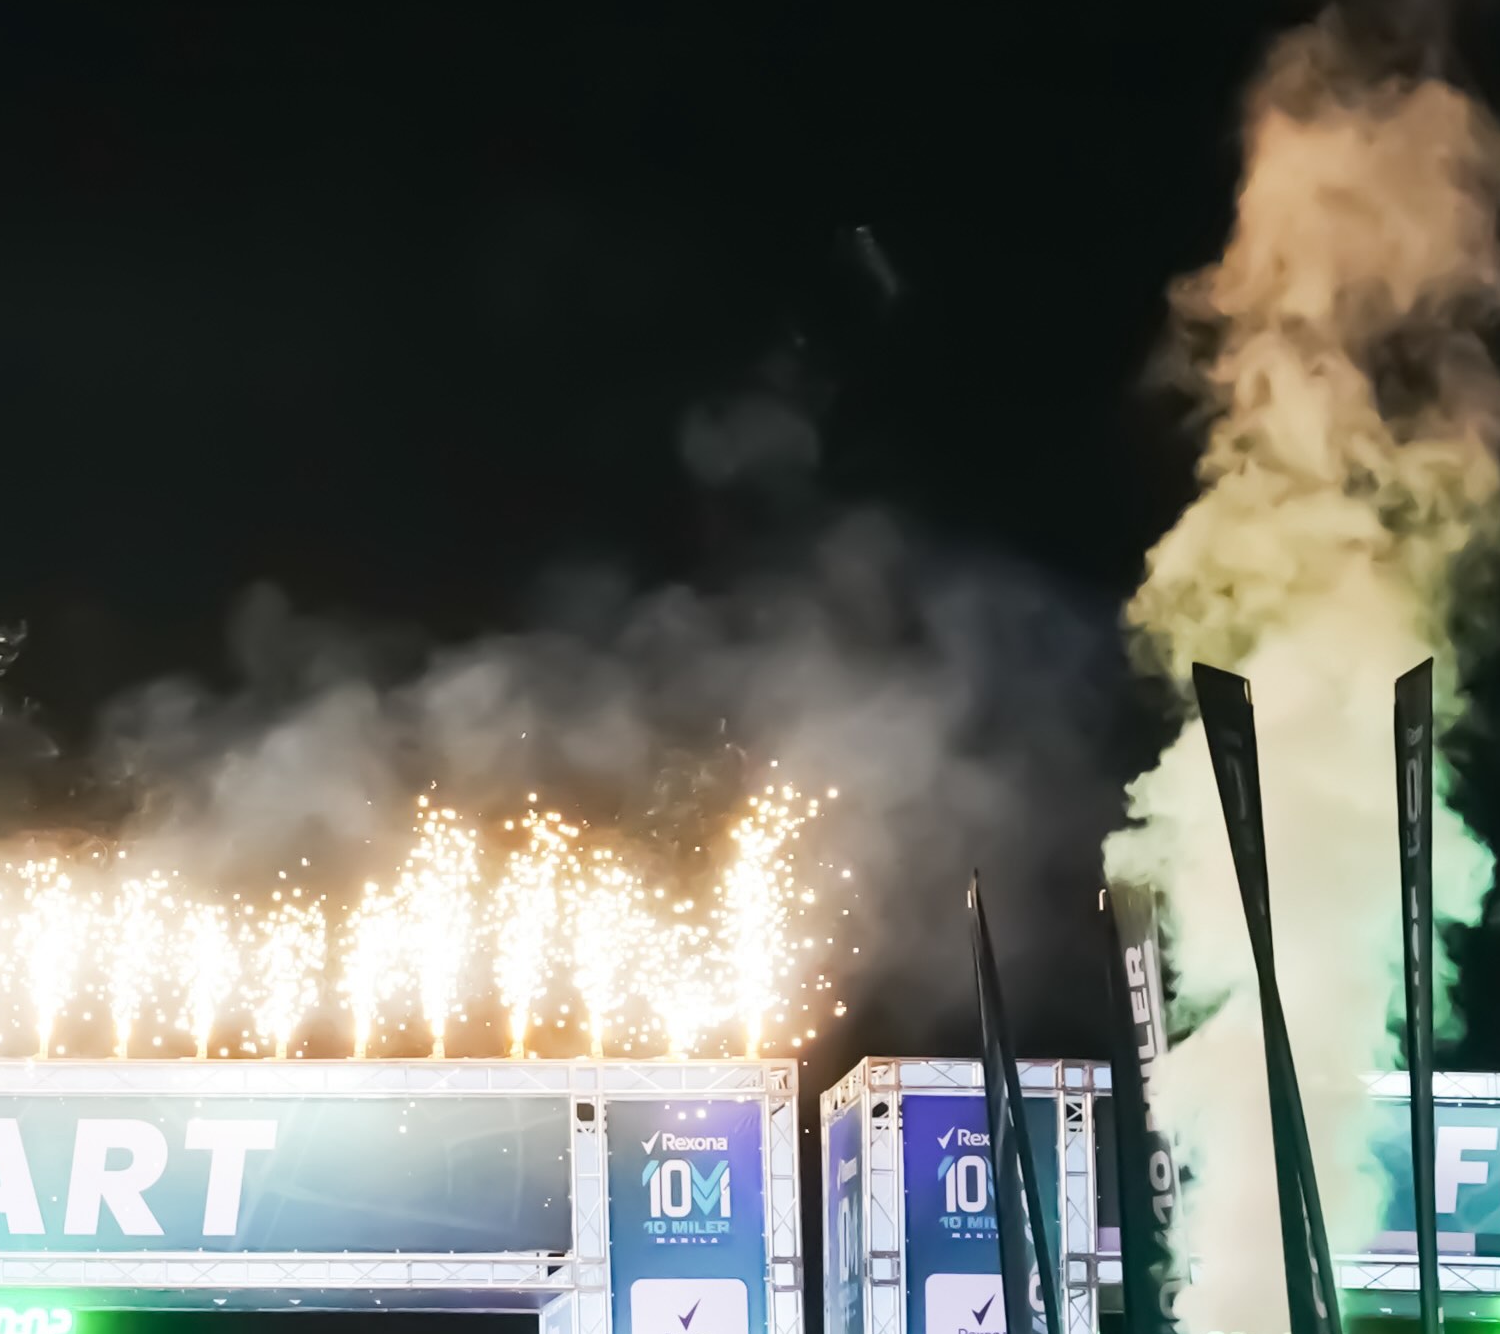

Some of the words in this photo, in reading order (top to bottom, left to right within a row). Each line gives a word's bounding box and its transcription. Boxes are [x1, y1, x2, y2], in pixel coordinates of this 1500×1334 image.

[661, 1133, 728, 1152] Rexona
[958, 1129, 991, 1147] Rex
[671, 1220, 730, 1234] MILER
